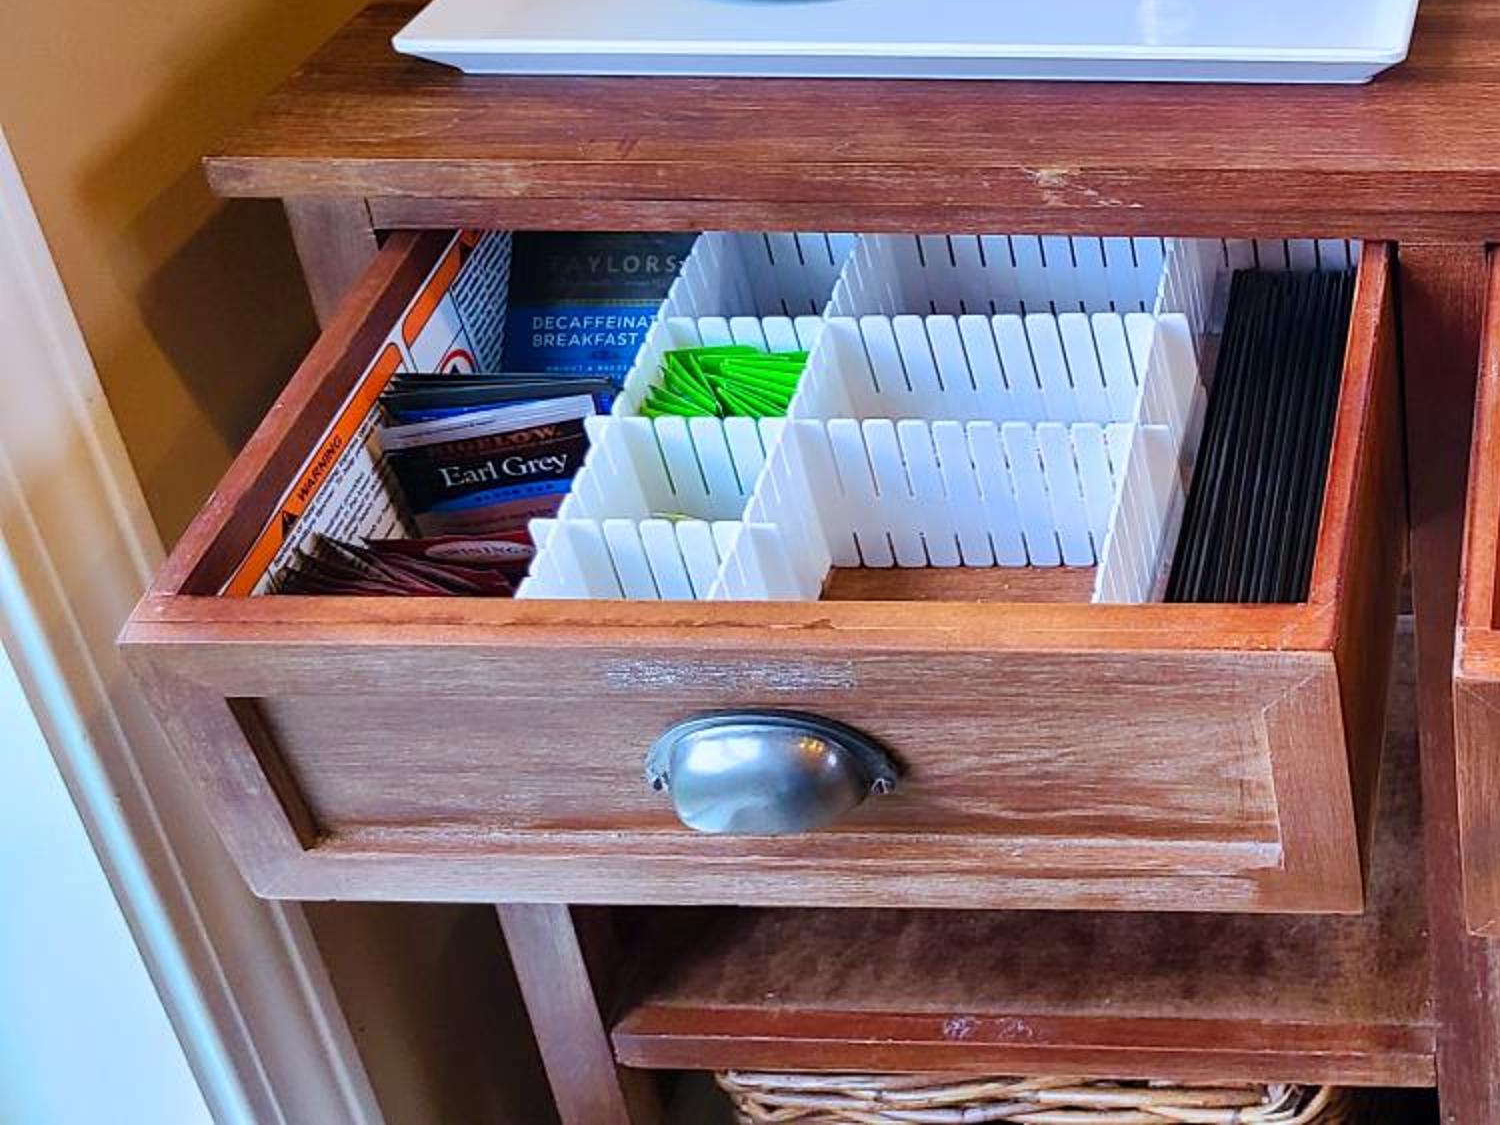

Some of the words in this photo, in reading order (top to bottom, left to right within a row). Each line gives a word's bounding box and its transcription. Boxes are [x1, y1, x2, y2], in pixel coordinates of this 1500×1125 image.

[549, 254, 678, 274] TAYLORS
[532, 332, 639, 348] BREAKFAST
[297, 435, 343, 503] WARNING
[438, 461, 500, 488] Earl
[501, 453, 568, 478] Grey
